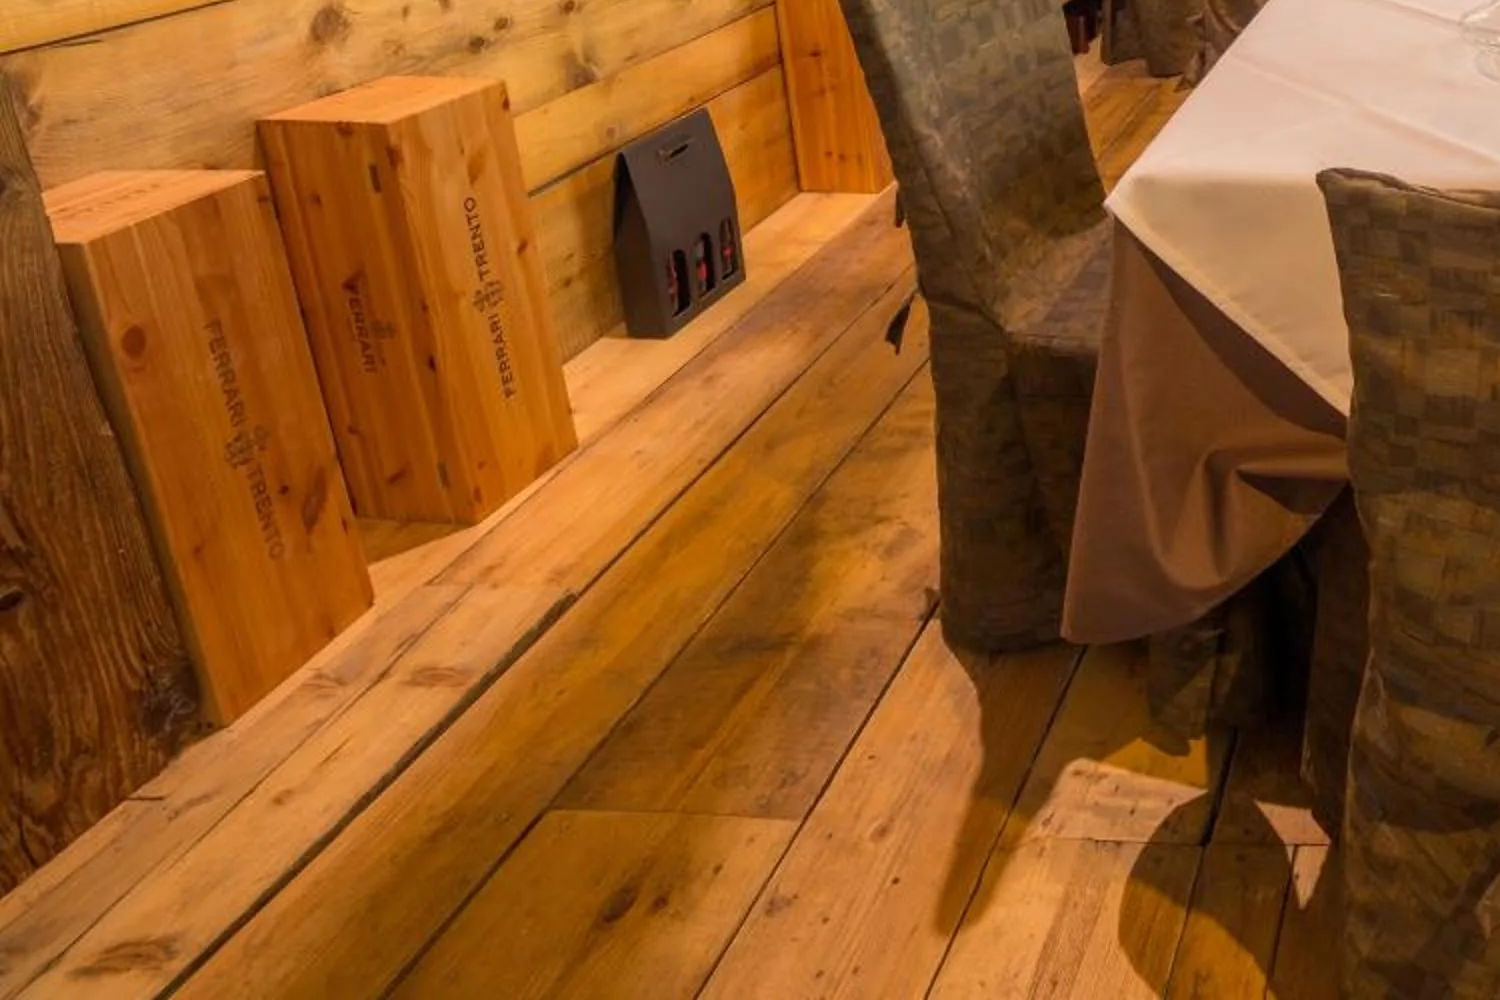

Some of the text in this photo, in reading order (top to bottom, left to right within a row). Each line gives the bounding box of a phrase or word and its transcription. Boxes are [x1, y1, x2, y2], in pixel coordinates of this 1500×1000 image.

[463, 197, 517, 399] FERRARI TRENTO
[204, 318, 286, 561] FERRARI TRENTO
